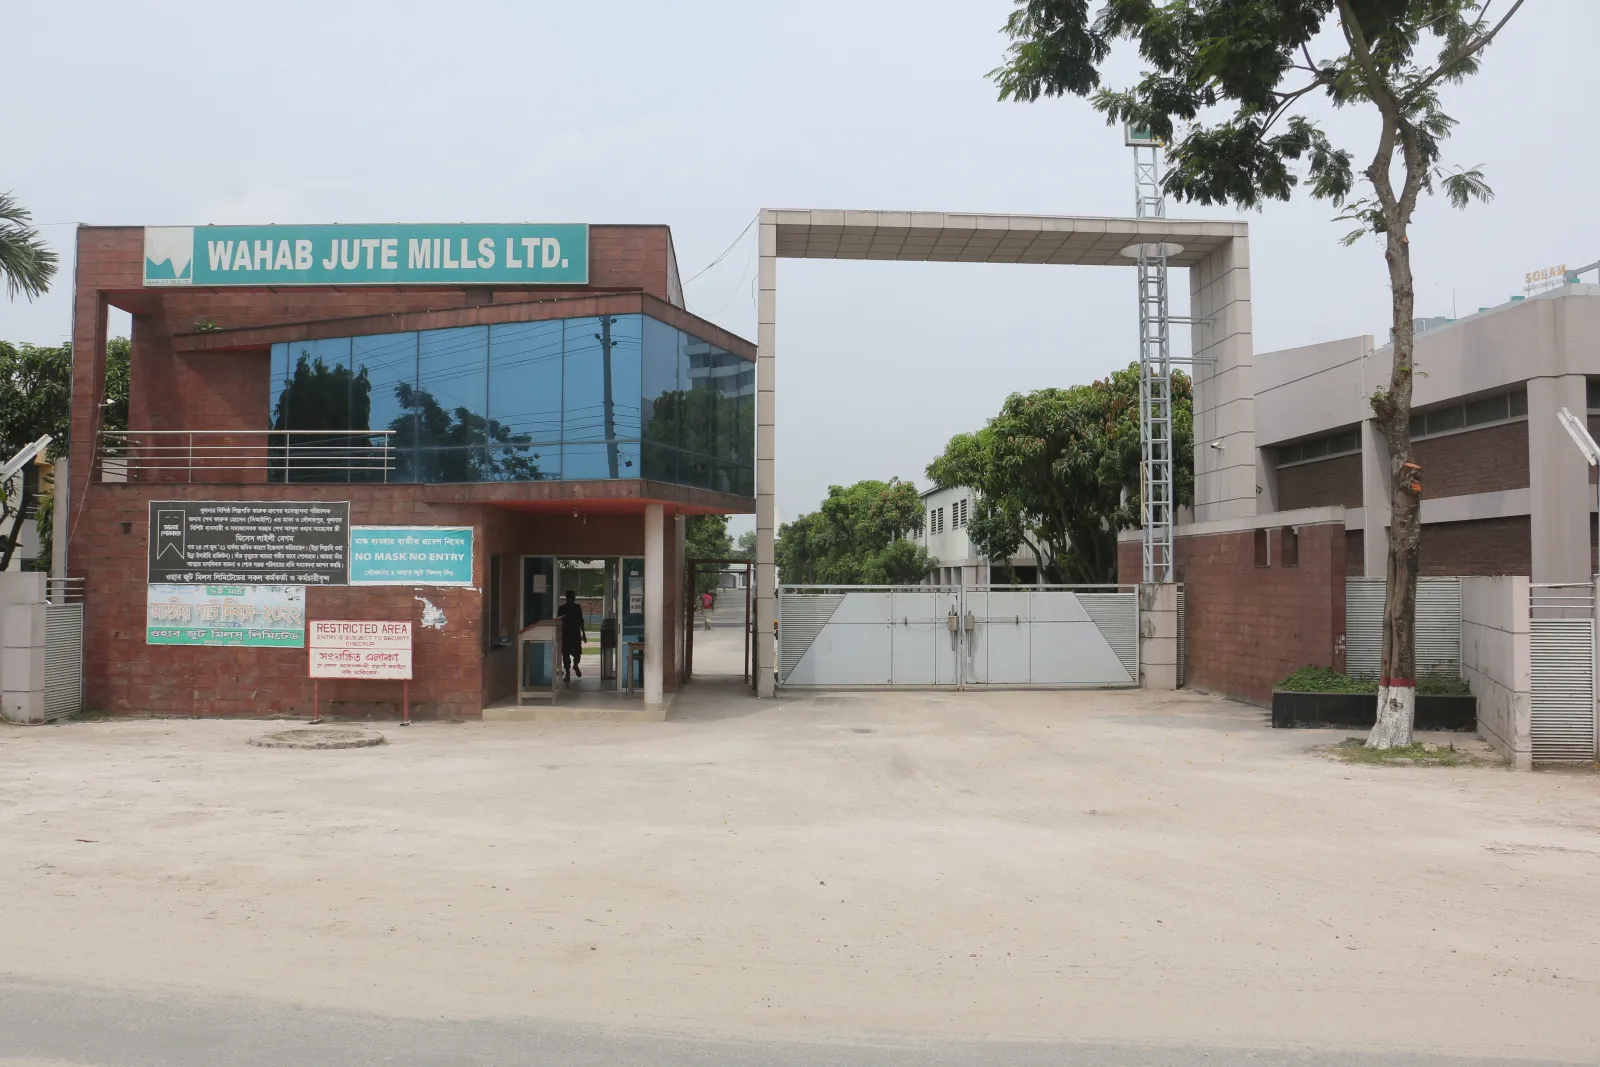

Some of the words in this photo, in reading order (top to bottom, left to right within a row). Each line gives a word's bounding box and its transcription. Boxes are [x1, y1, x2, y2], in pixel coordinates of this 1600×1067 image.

[208, 240, 313, 270] WAHAB
[322, 239, 398, 270] JUTE
[408, 238, 495, 269] MILLS
[506, 238, 568, 268] LTD.
[355, 552, 372, 561] NO
[374, 552, 406, 561] MASK
[410, 553, 426, 561] NO
[194, 600, 219, 621] পাট
[316, 623, 378, 634] RESTRICTED
[382, 624, 408, 634] AREA
[150, 630, 180, 639] ওহাব
[184, 629, 206, 640] জুট
[248, 631, 299, 641] লিমিটেড
[319, 650, 361, 662] সংরক্ষিত
[365, 652, 399, 662] এলাকা
